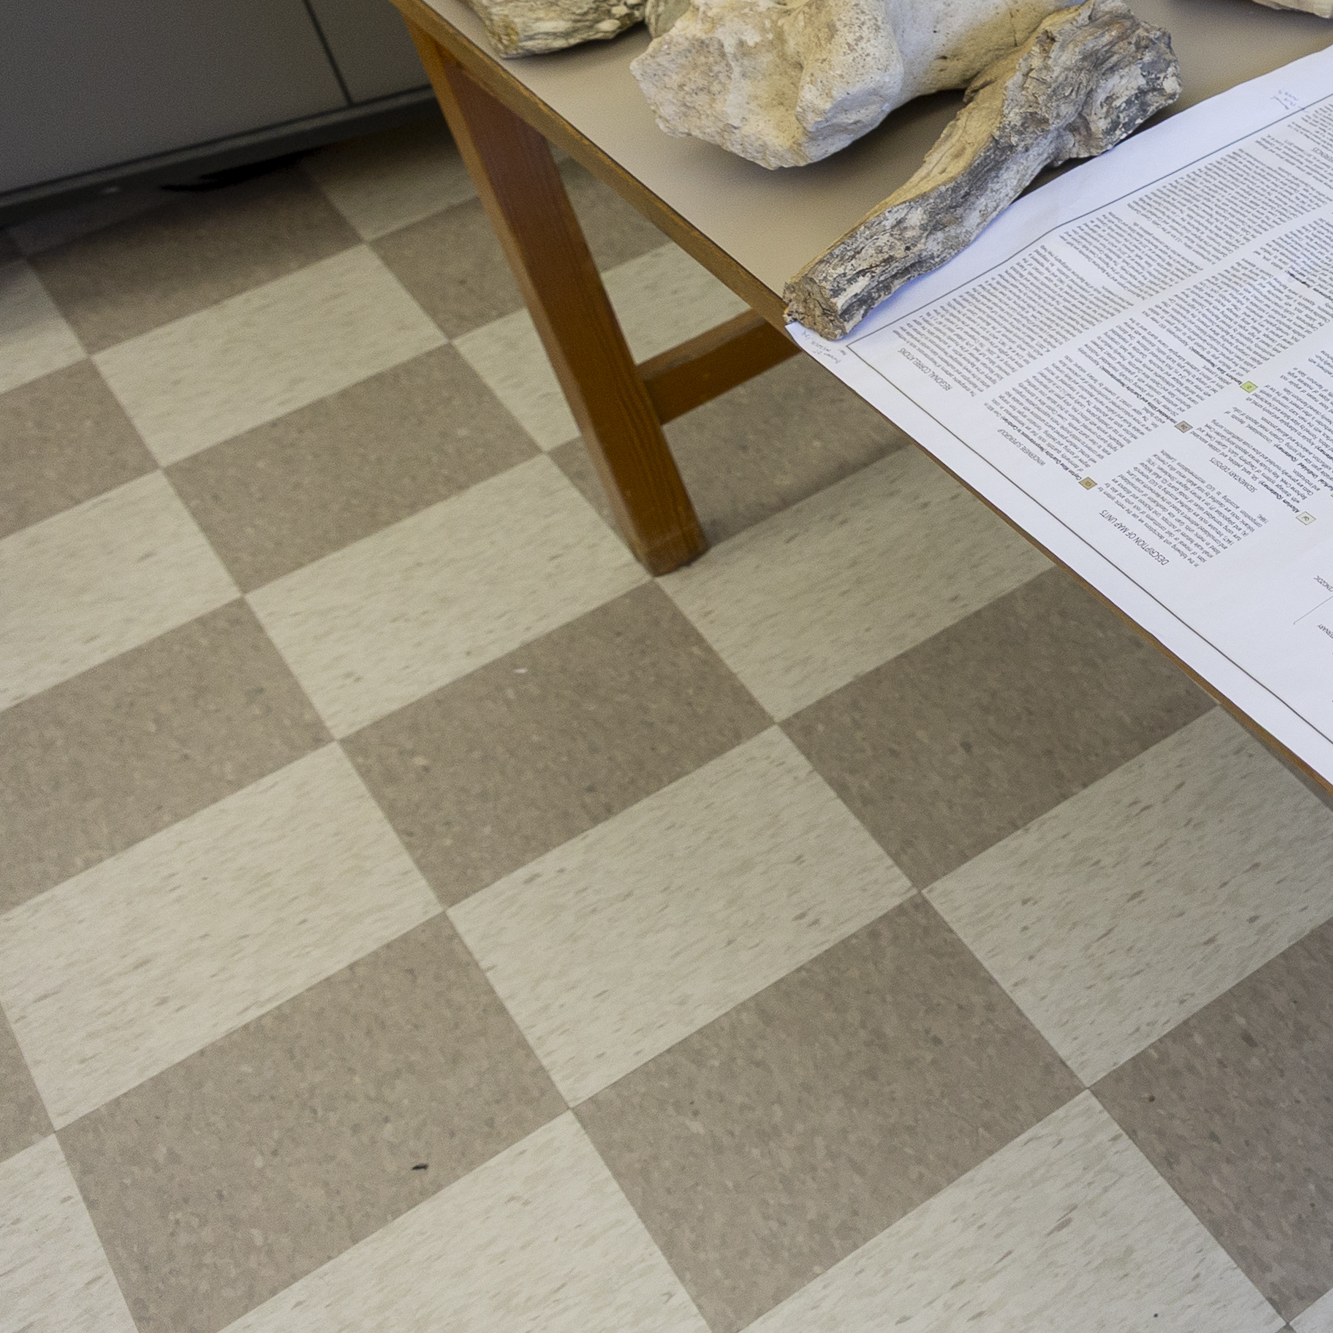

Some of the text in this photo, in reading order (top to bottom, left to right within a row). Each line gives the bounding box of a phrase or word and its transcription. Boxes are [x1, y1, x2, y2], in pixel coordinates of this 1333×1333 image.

[1208, 456, 1258, 493] SEDIMENTARY DEPOSITS
[1098, 508, 1170, 566] DESCRIPTION OF MAP UNITS
